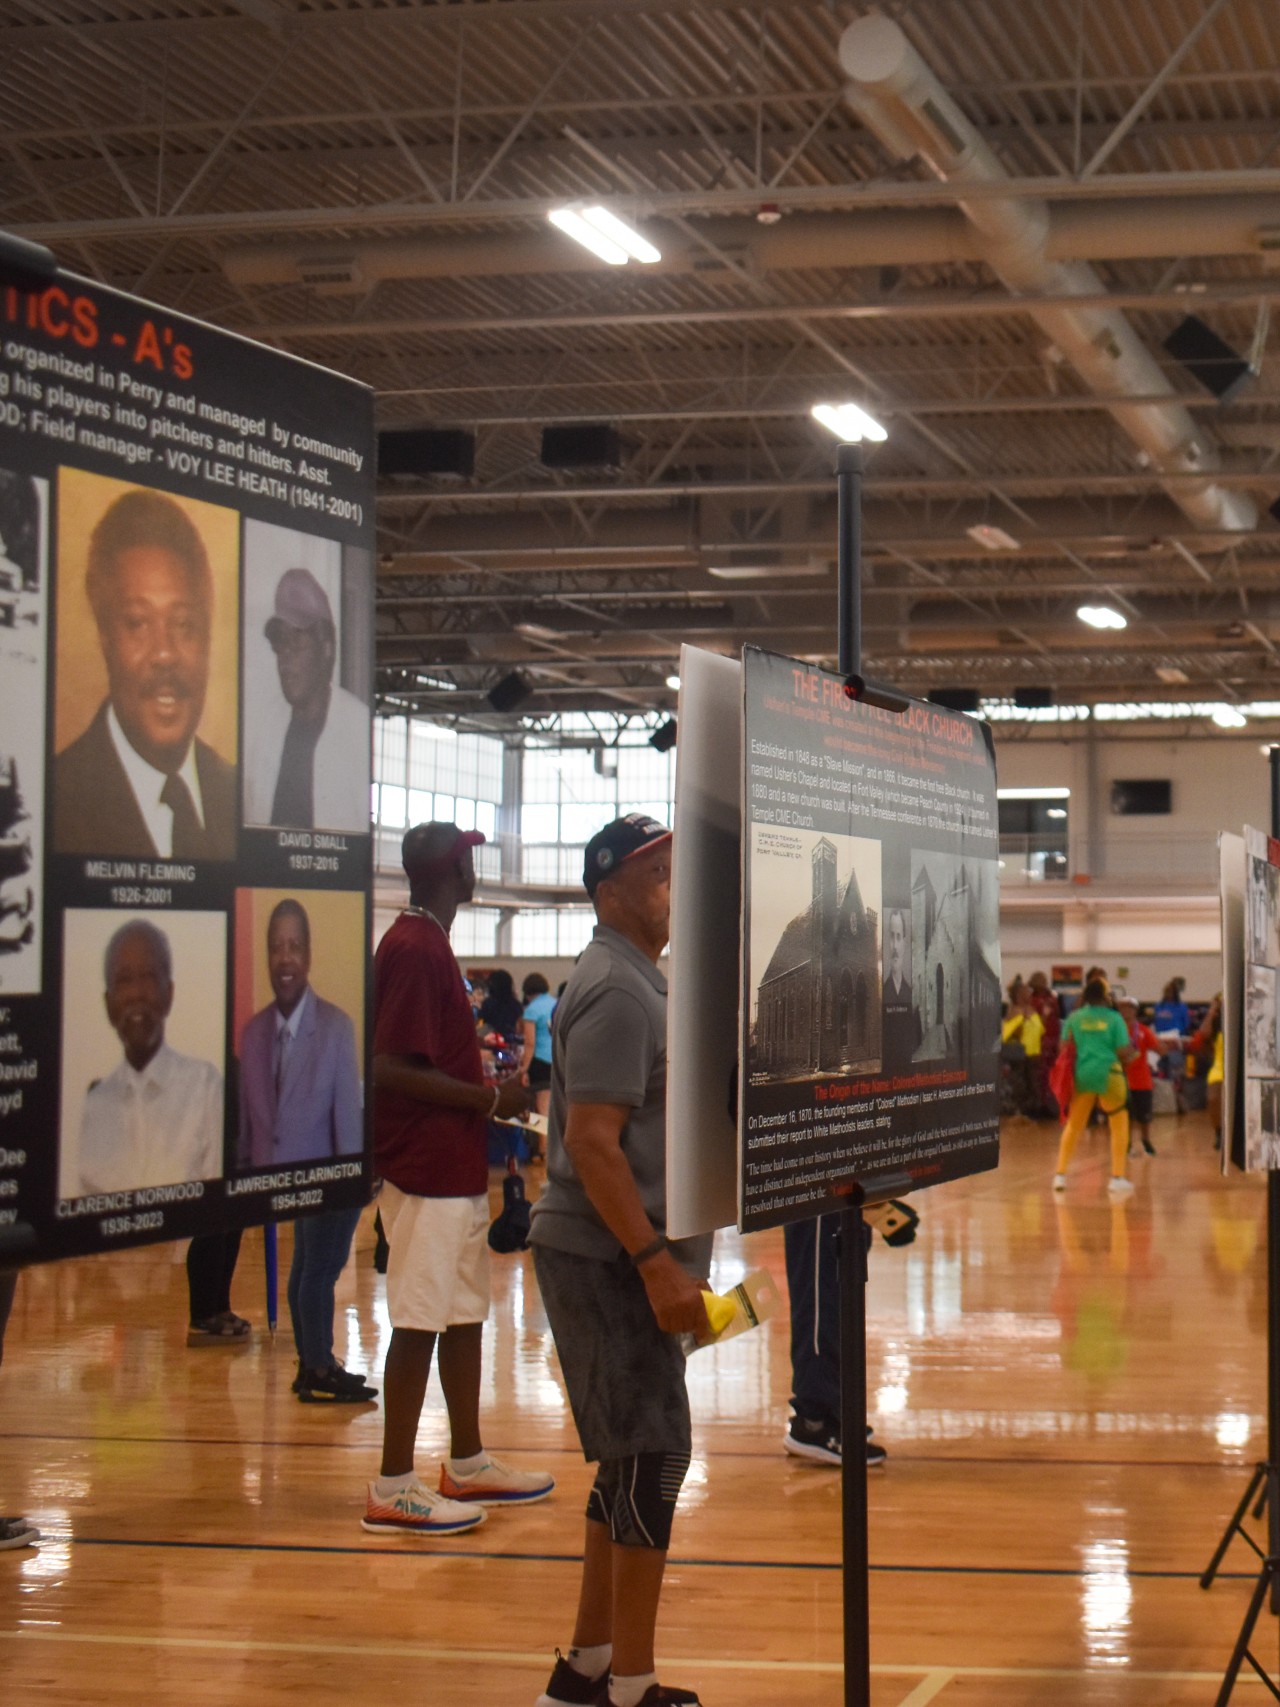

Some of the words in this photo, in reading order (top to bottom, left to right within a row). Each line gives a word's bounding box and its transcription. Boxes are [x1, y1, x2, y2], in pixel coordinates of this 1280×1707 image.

[134, 320, 194, 380] A's
[5, 343, 94, 383] organized
[99, 367, 114, 389] in
[119, 372, 162, 408] Perry
[167, 390, 195, 414] and
[199, 401, 265, 436] managed
[273, 422, 289, 448] by
[293, 434, 363, 472] community
[14, 374, 42, 399] his
[46, 382, 111, 421] players
[115, 401, 146, 430] into
[150, 420, 214, 451] pitchers
[218, 436, 245, 461] and
[248, 438, 296, 474] hitters.
[299, 459, 332, 485] Asst.
[31, 409, 76, 441] Field
[80, 428, 153, 464] manager
[167, 449, 201, 477] VOY
[204, 461, 235, 487] LEE
[238, 471, 288, 501] HEATH
[290, 490, 363, 525] (1941-2001)
[791, 668, 818, 703] THE
[932, 711, 972, 745] CHURCH
[750, 738, 786, 760] Established
[787, 746, 794, 761] in
[810, 755, 818, 766] as
[866, 766, 876, 779] and
[750, 764, 772, 778] named
[774, 766, 796, 782] Usher's
[797, 770, 819, 789] Chapel
[819, 776, 830, 789] and
[831, 777, 850, 793] located
[857, 782, 869, 796] Fort
[768, 787, 780, 801] and
[781, 791, 786, 802] a
[786, 792, 799, 804] new
[800, 792, 820, 808] church
[820, 797, 832, 810] was
[750, 804, 774, 824] Temple
[774, 808, 790, 823] CME
[791, 811, 814, 826] Church.
[279, 832, 311, 849] DAVID
[314, 833, 348, 851] SMALL
[87, 861, 136, 879] MELVIN
[139, 863, 196, 881] FLEMING
[289, 854, 339, 871] 1937-2016
[110, 886, 172, 904] 1926-2001
[748, 1115, 757, 1129] On
[758, 1111, 787, 1127] December
[814, 1106, 822, 1119] the
[823, 1103, 846, 1118] founding
[846, 1100, 868, 1114] members
[748, 1132, 775, 1149] submitted
[776, 1130, 788, 1144] their
[789, 1127, 806, 1144] report
[806, 1127, 812, 1139] to
[813, 1125, 828, 1138] White
[227, 1171, 292, 1197] LAWRENCE
[294, 1161, 362, 1188] CLARINGTON
[57, 1190, 132, 1220] CLARENCE
[135, 1182, 204, 1209] NORWOOD
[272, 1189, 323, 1211] 1954-2022
[101, 1210, 164, 1236] 1936-2023
